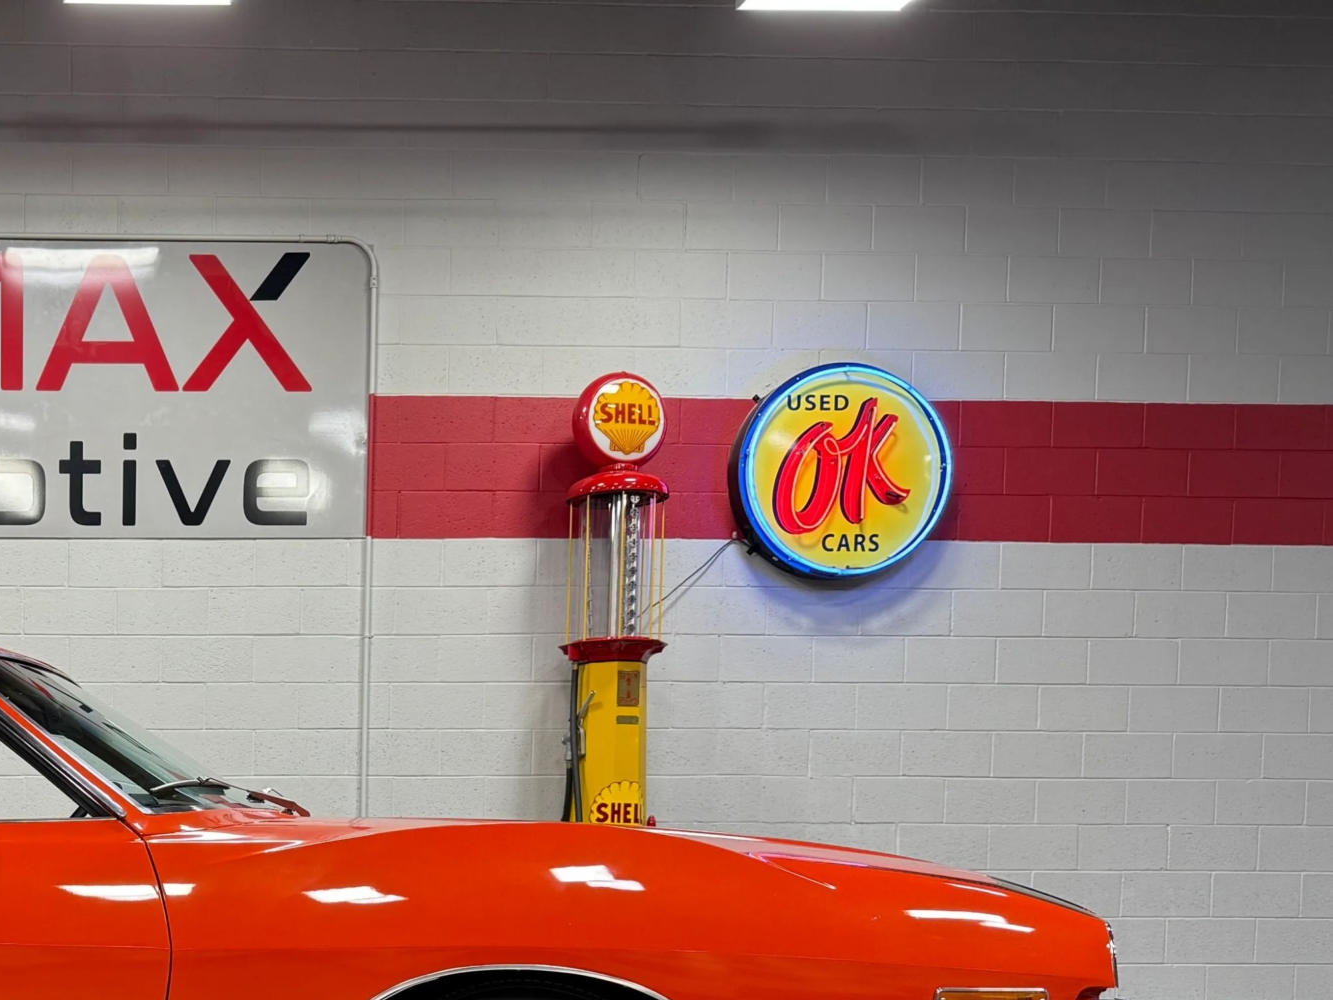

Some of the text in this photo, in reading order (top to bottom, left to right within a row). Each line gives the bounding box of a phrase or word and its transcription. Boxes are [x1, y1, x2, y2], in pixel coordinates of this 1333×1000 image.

[786, 394, 850, 411] USED
[599, 402, 657, 426] SHELL
[771, 397, 912, 535] OK
[821, 533, 880, 552] CARS
